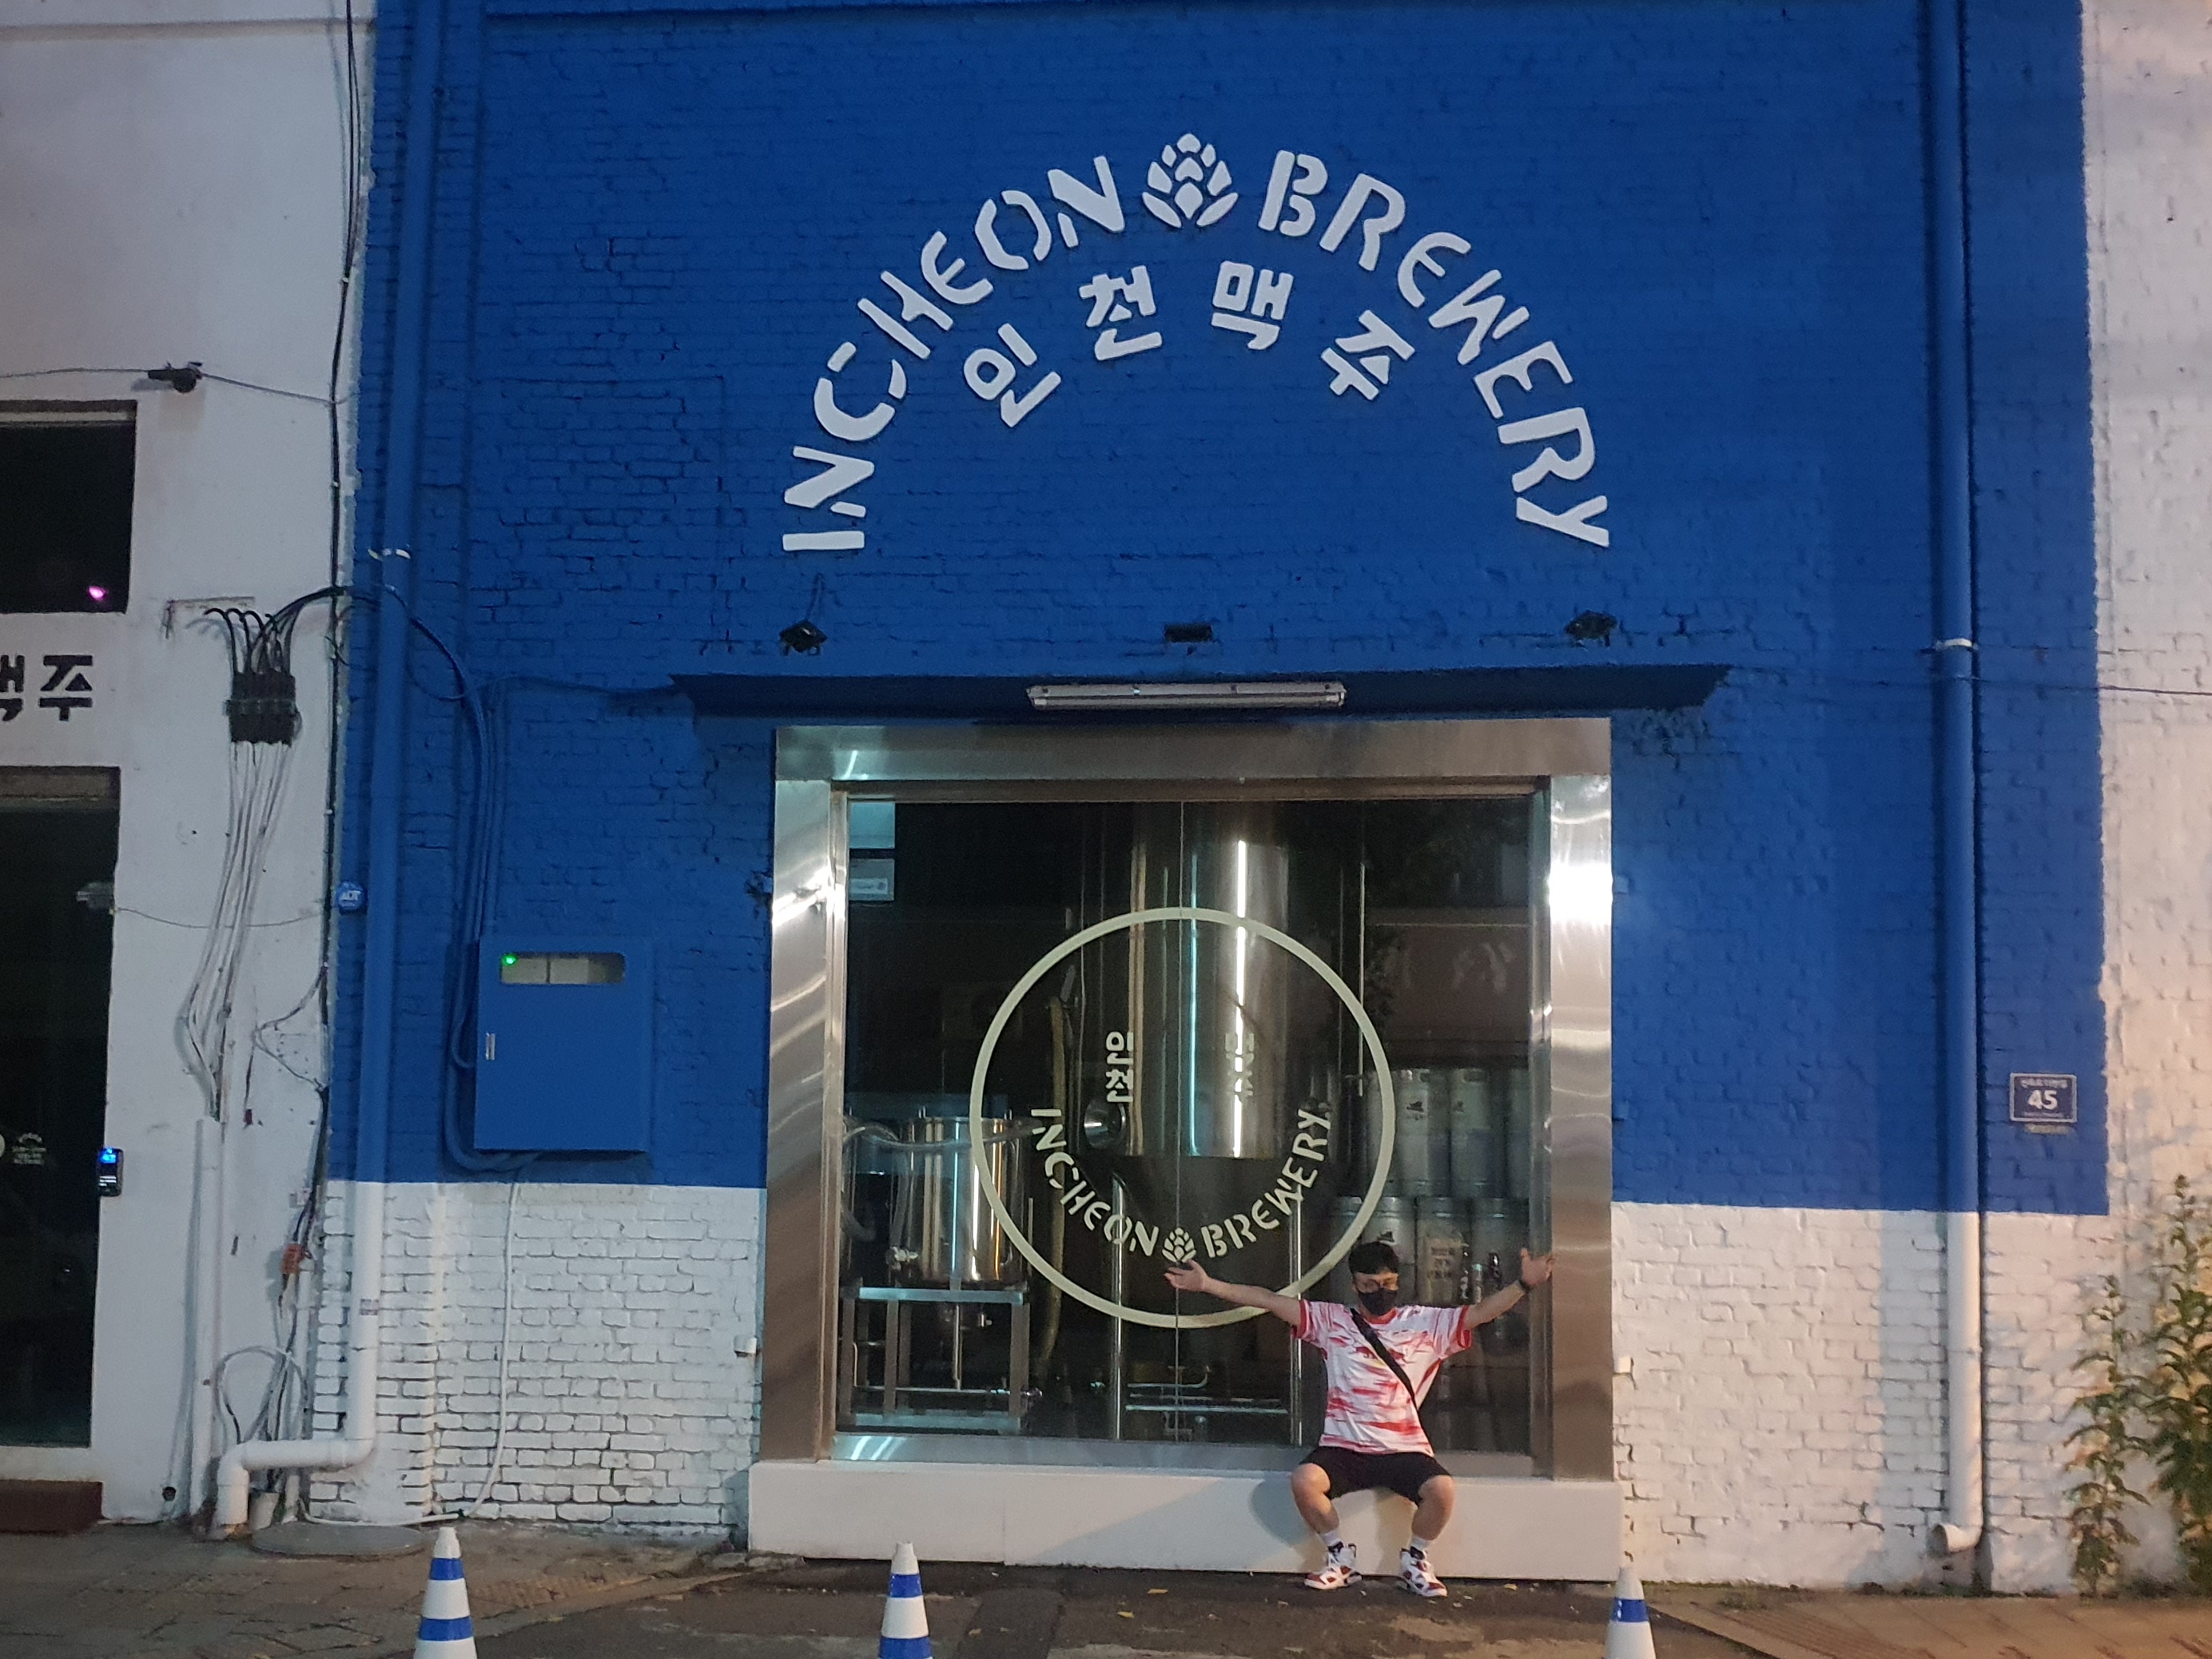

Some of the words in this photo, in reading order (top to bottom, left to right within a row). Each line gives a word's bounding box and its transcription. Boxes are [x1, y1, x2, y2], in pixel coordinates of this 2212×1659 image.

[782, 156, 1125, 551] INCHEON
[1258, 149, 1610, 547] BREWERY
[1105, 1031, 1134, 1103] 인천
[2027, 1089, 2059, 1110] 45
[1030, 1108, 1160, 1257] INCHEON
[1200, 1108, 1332, 1259] BREWERY
